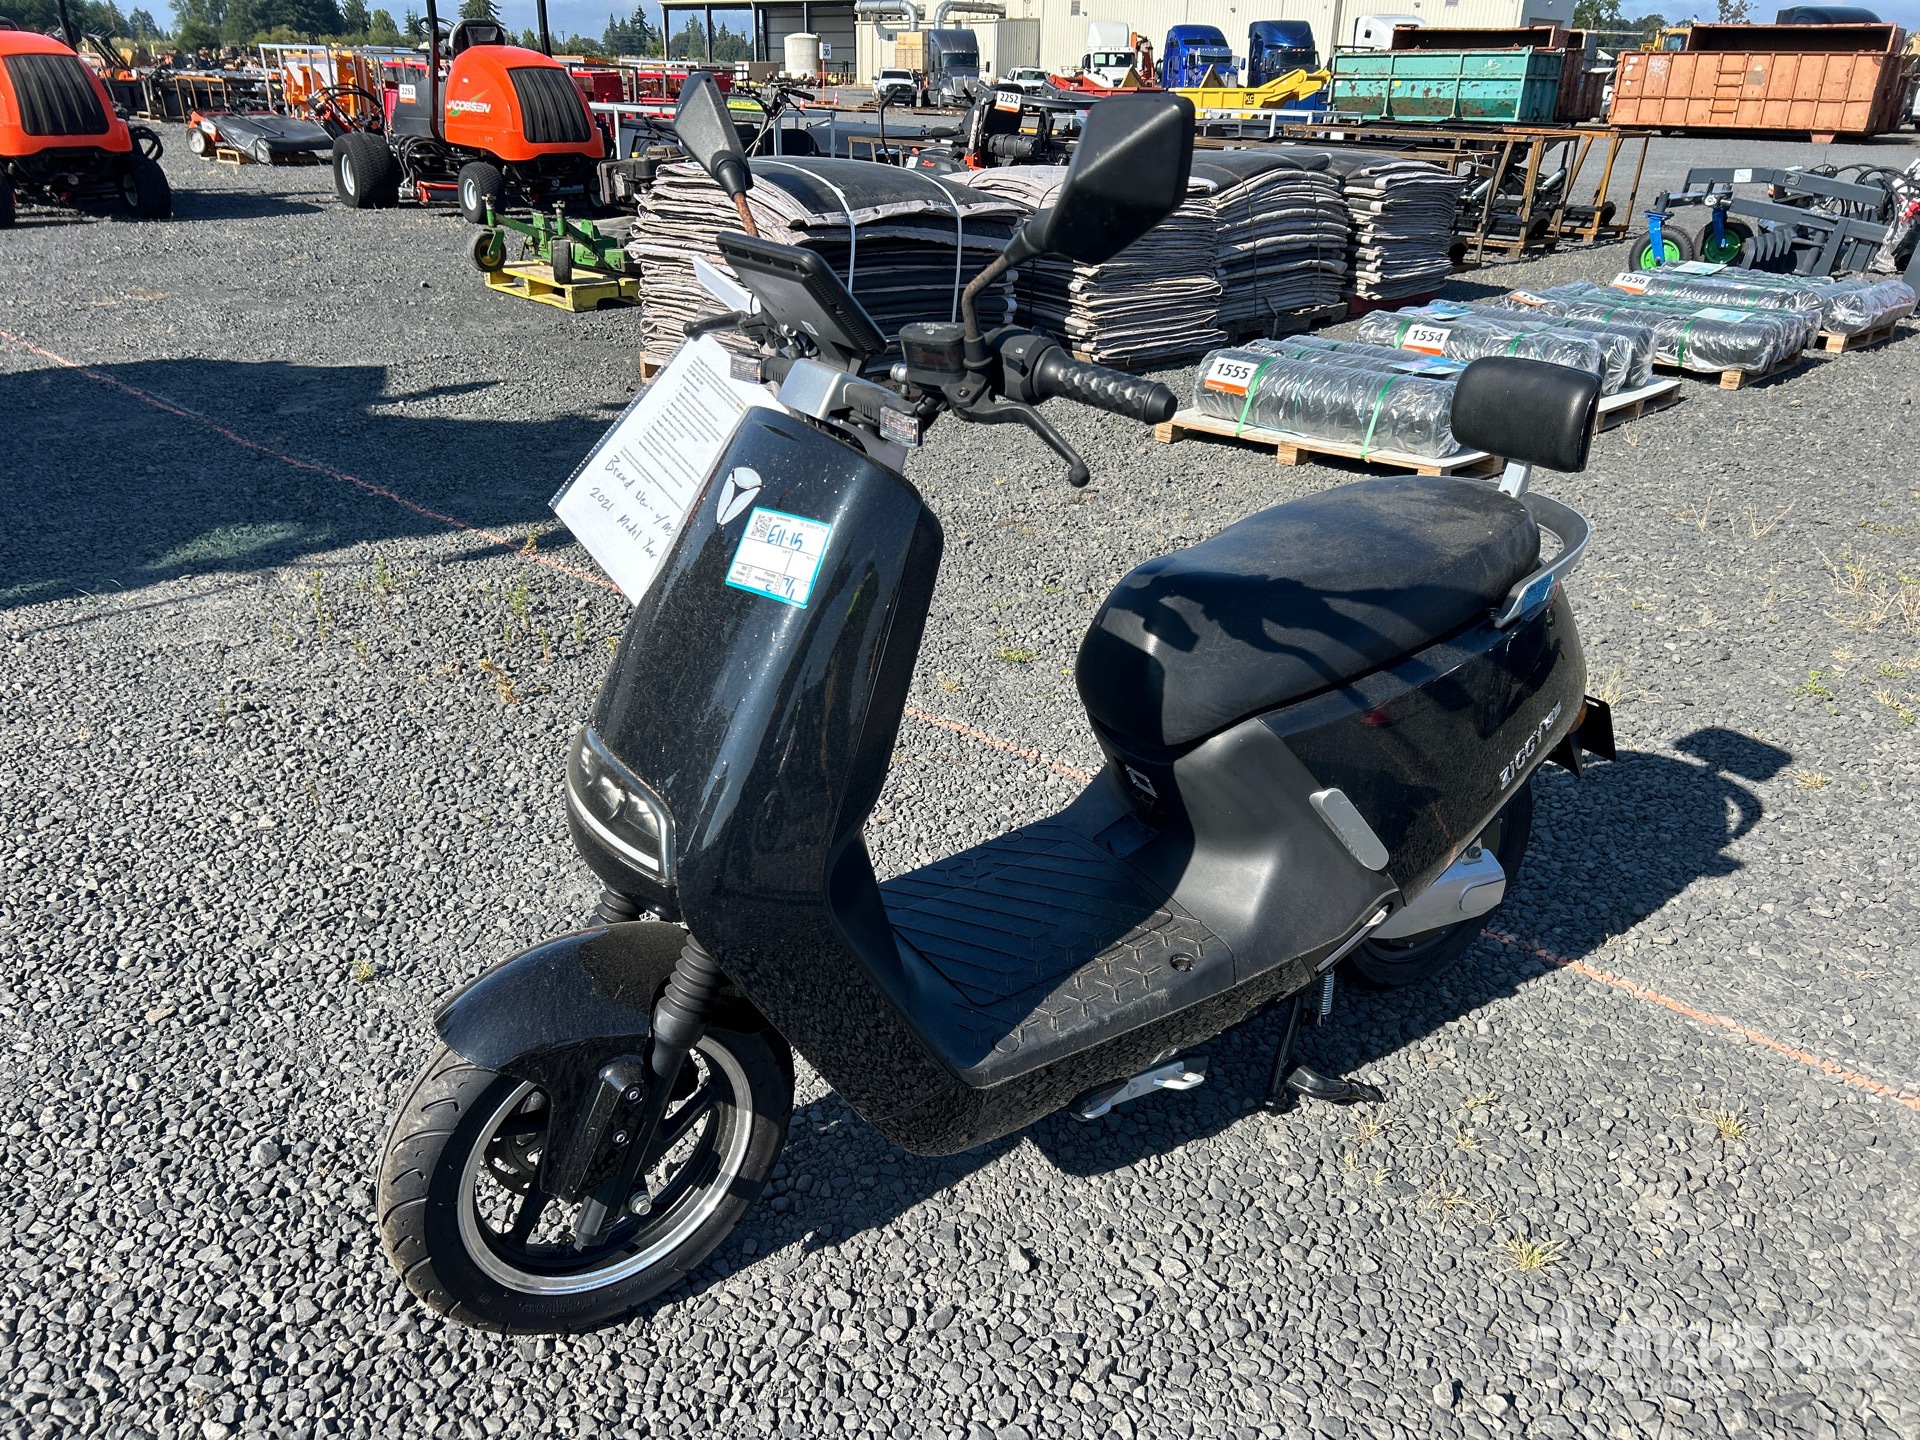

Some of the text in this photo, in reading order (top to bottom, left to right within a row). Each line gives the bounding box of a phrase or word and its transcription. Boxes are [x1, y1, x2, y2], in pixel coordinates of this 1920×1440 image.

[401, 87, 415, 96] 2253
[1000, 92, 1019, 104] 2252
[446, 99, 492, 113] JACOBSEN
[1620, 274, 1648, 285] 1556
[1412, 329, 1445, 343] 1554
[1216, 362, 1251, 380] 1555
[604, 454, 636, 490] Brand
[589, 487, 658, 559] 2021 Model Year
